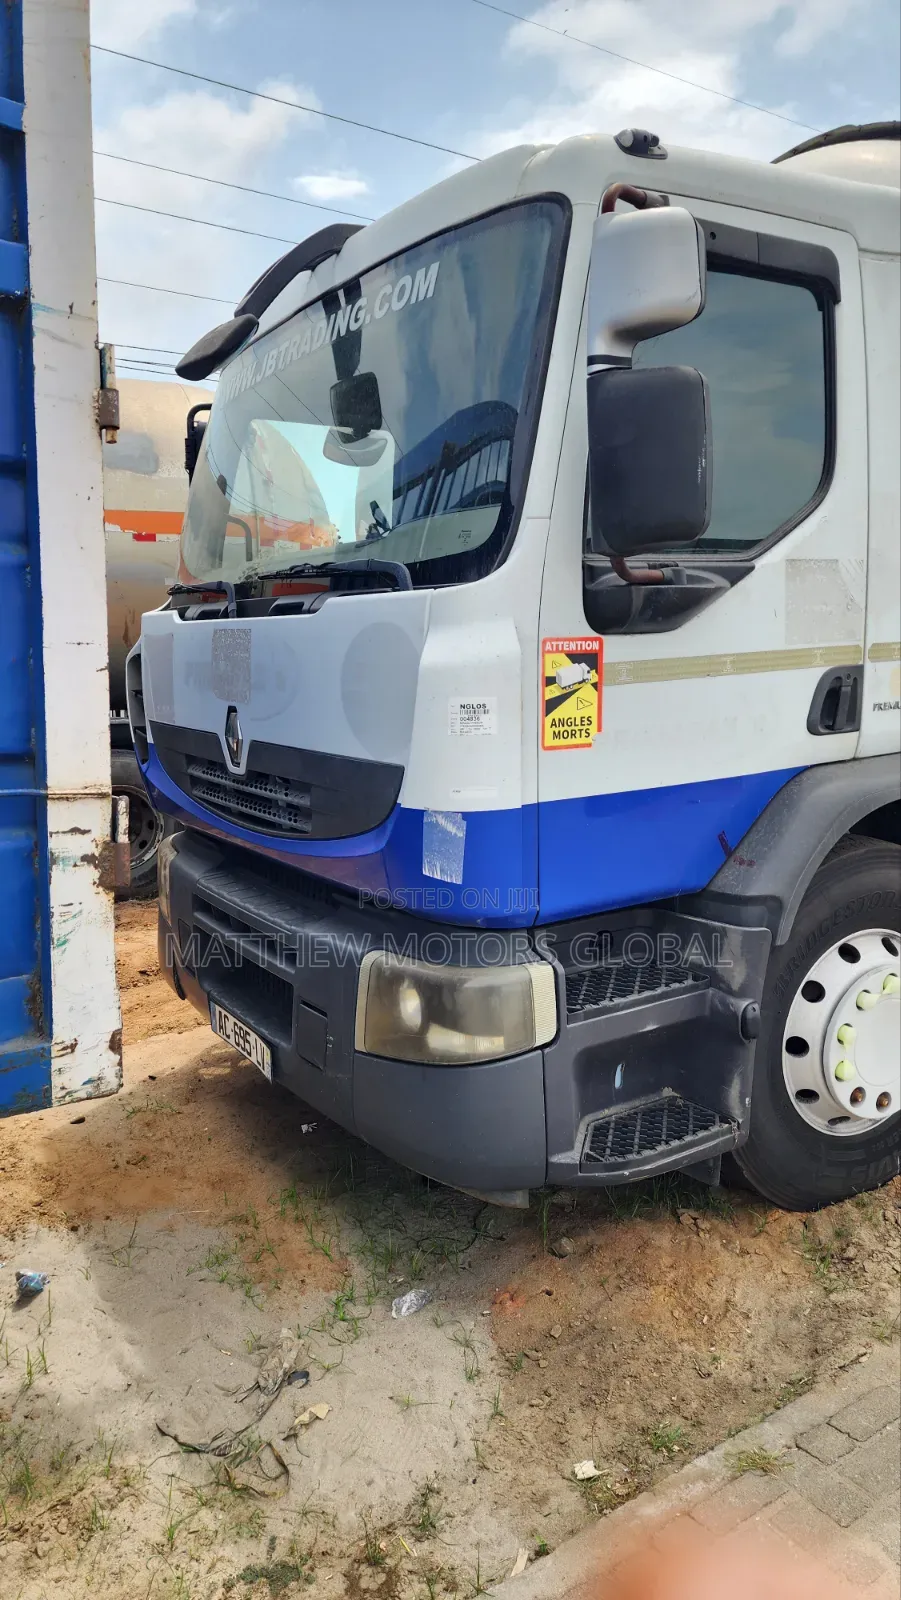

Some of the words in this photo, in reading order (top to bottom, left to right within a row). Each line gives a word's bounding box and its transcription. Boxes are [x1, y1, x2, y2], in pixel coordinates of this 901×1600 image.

[545, 640, 600, 651] ATTENTION
[550, 716, 593, 728] ANGLES
[552, 728, 591, 740] MORTS
